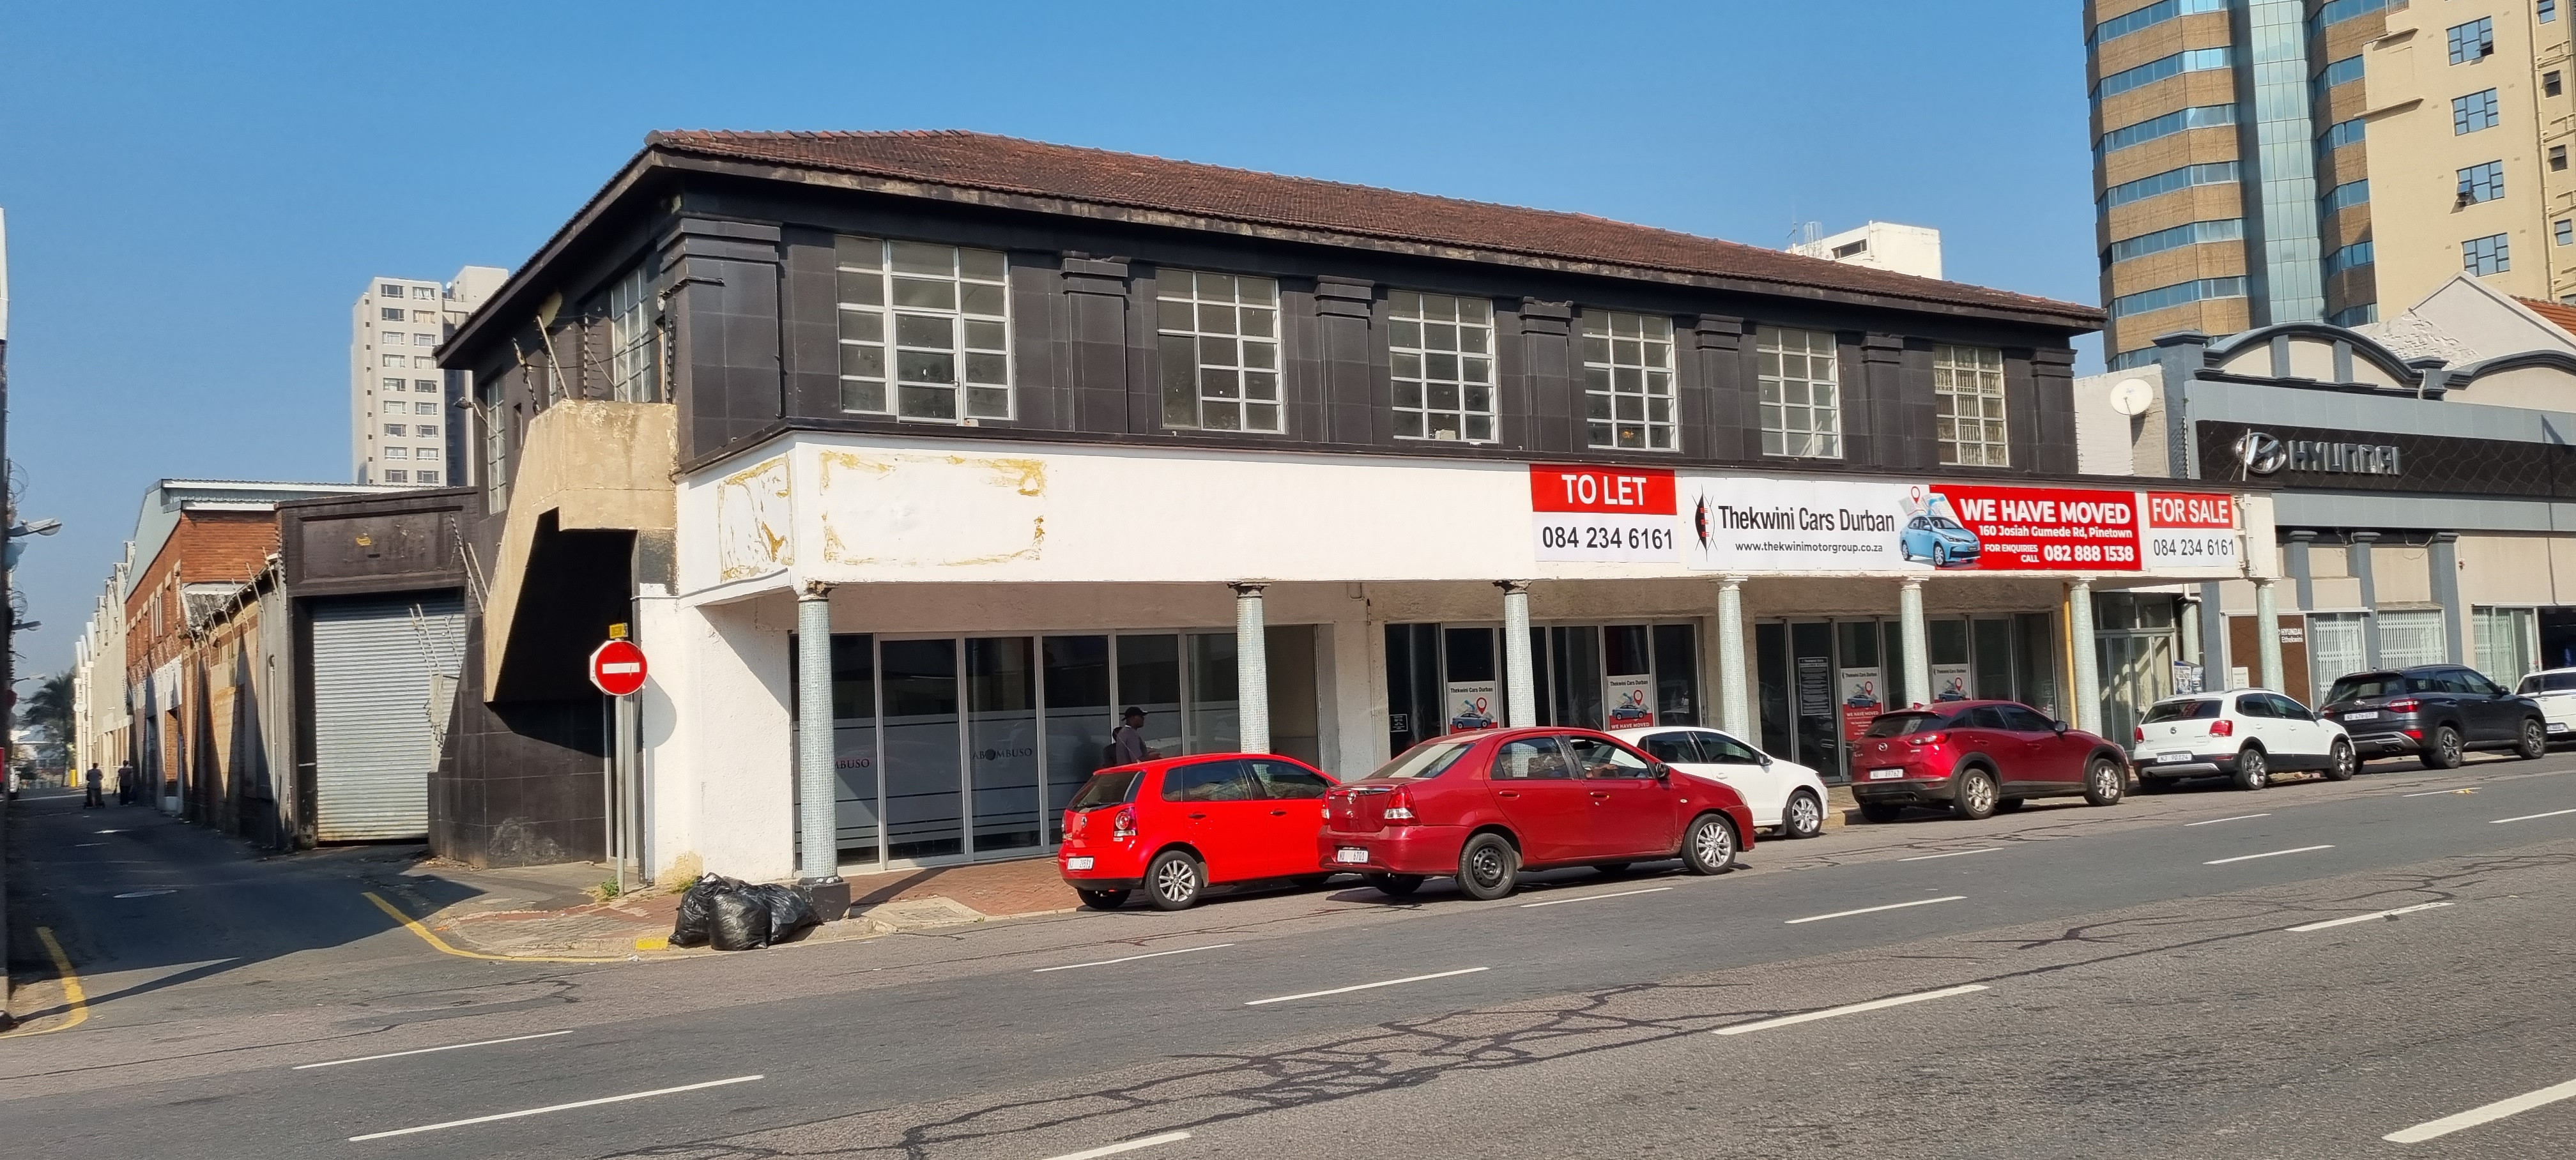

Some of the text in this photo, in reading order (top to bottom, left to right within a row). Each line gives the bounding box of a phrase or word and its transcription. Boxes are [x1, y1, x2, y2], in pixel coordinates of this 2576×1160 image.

[2288, 440, 2401, 475] HYUNDAI
[1561, 474, 1647, 505] TO LET
[1718, 505, 1894, 531] Thekwini Cars Durban
[1959, 498, 2131, 524] WE HAVE MOVED
[2152, 498, 2229, 523] FOR SALE
[1542, 526, 1672, 549] 084 234 6161
[1979, 524, 2133, 539] 160 Josiah Gumede Rd, Pinetown
[1735, 541, 1883, 554] www.thekwinimotorgroup.co.za
[1984, 544, 2038, 553] FOR ENQUIRIES
[2044, 545, 2134, 561] 082 888 1538
[2154, 538, 2234, 556] 084 234 6161
